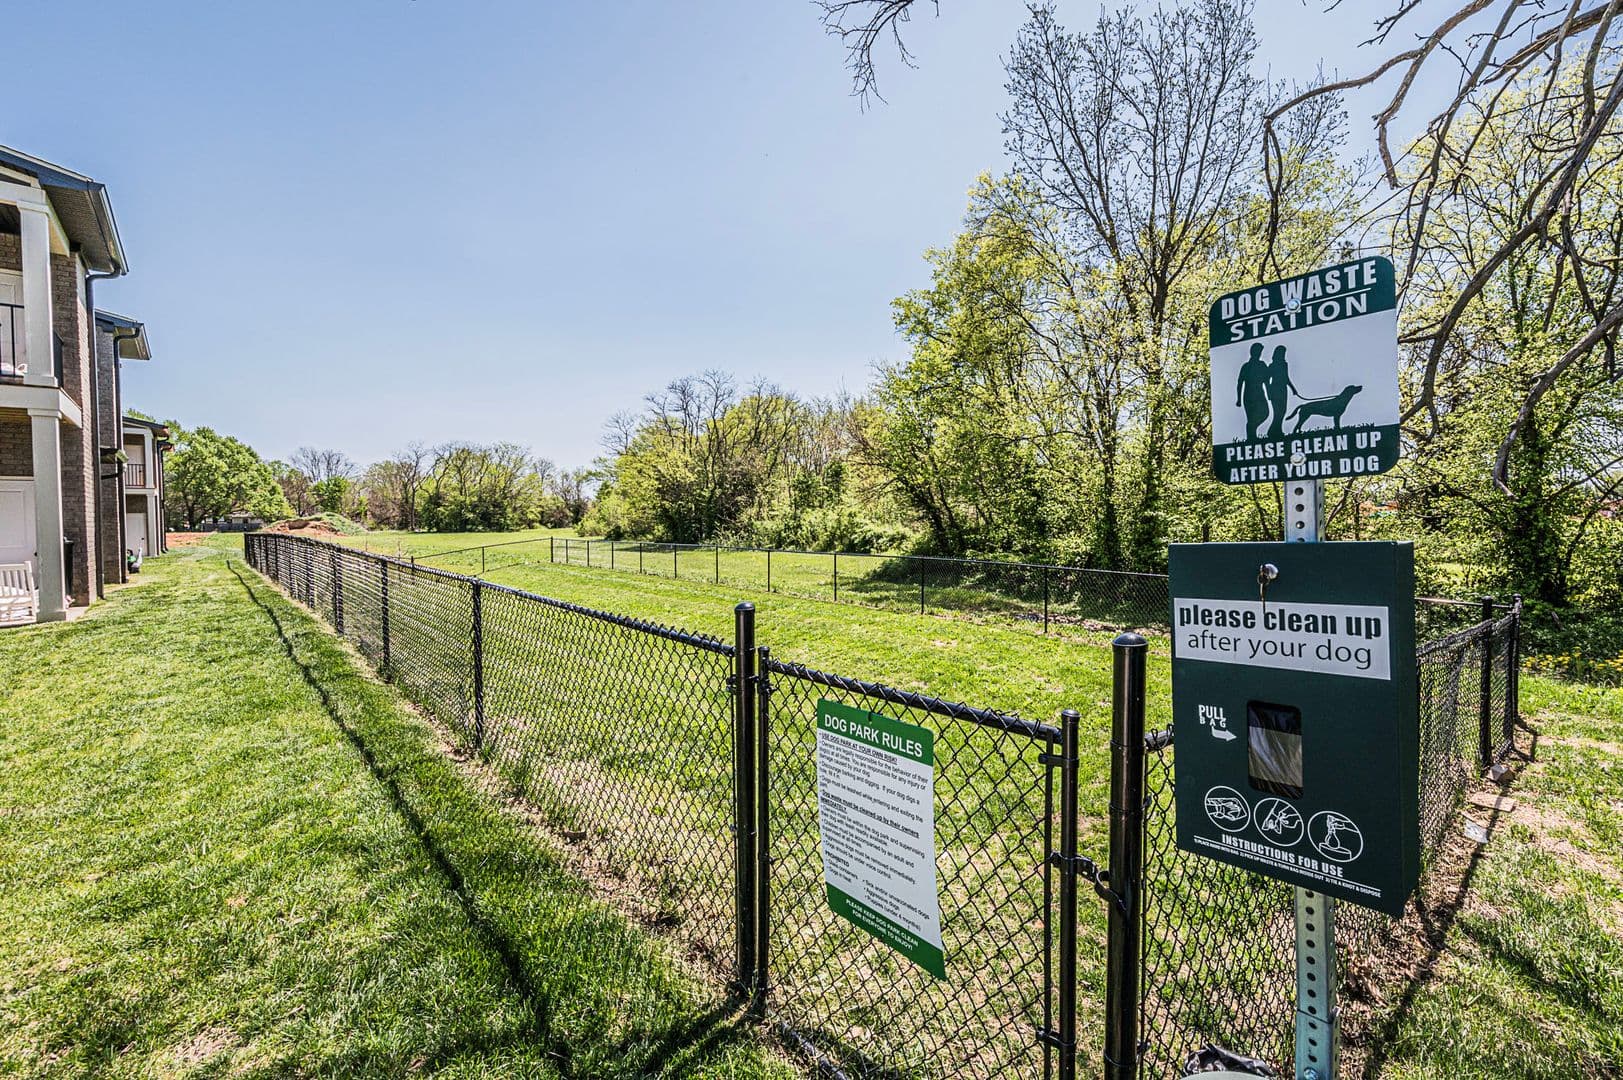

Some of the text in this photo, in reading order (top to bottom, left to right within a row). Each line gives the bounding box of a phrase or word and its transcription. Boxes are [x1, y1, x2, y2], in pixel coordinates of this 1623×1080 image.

[1222, 260, 1377, 320] DOG WASTE
[1230, 293, 1367, 342] STATION
[1226, 431, 1382, 462] PLEASE CLEAN UP
[1230, 455, 1380, 482] AFTER YOUR DOG
[1179, 605, 1381, 640] please clean up
[1188, 630, 1371, 670] after your dog
[1198, 704, 1224, 720] PULL
[824, 714, 923, 758] DOG PARK RULES
[1222, 833, 1295, 863] INSTRUCTIONS
[1298, 856, 1318, 870] FOR
[1322, 862, 1344, 878] USE
